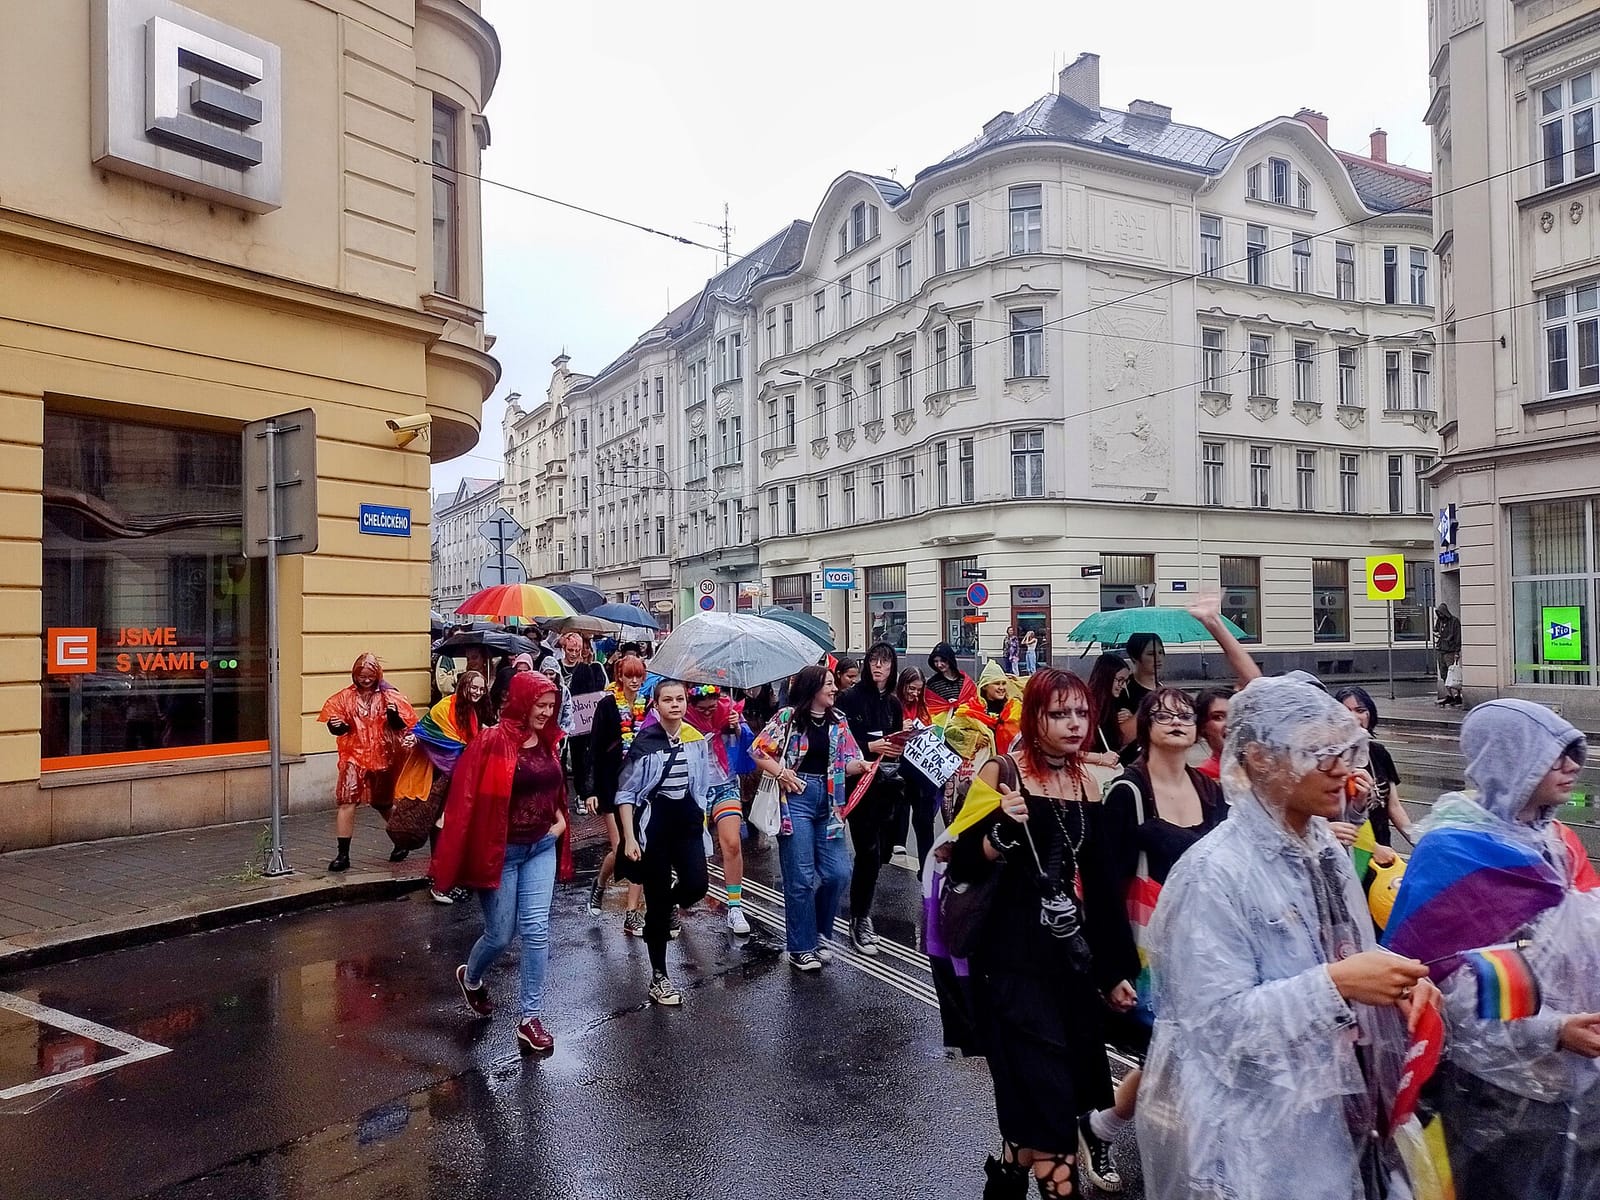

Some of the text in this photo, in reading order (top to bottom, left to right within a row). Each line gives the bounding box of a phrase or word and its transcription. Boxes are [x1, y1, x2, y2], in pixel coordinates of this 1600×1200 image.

[363, 511, 408, 530] CHELČICKÉHO
[703, 583, 713, 591] 30
[116, 626, 177, 647] JSME
[1555, 625, 1569, 637] Fio
[116, 653, 131, 672] S
[904, 743, 922, 762] THE
[920, 756, 949, 785] BRAVE
[925, 748, 946, 769] FOR
[945, 751, 961, 765] IS
